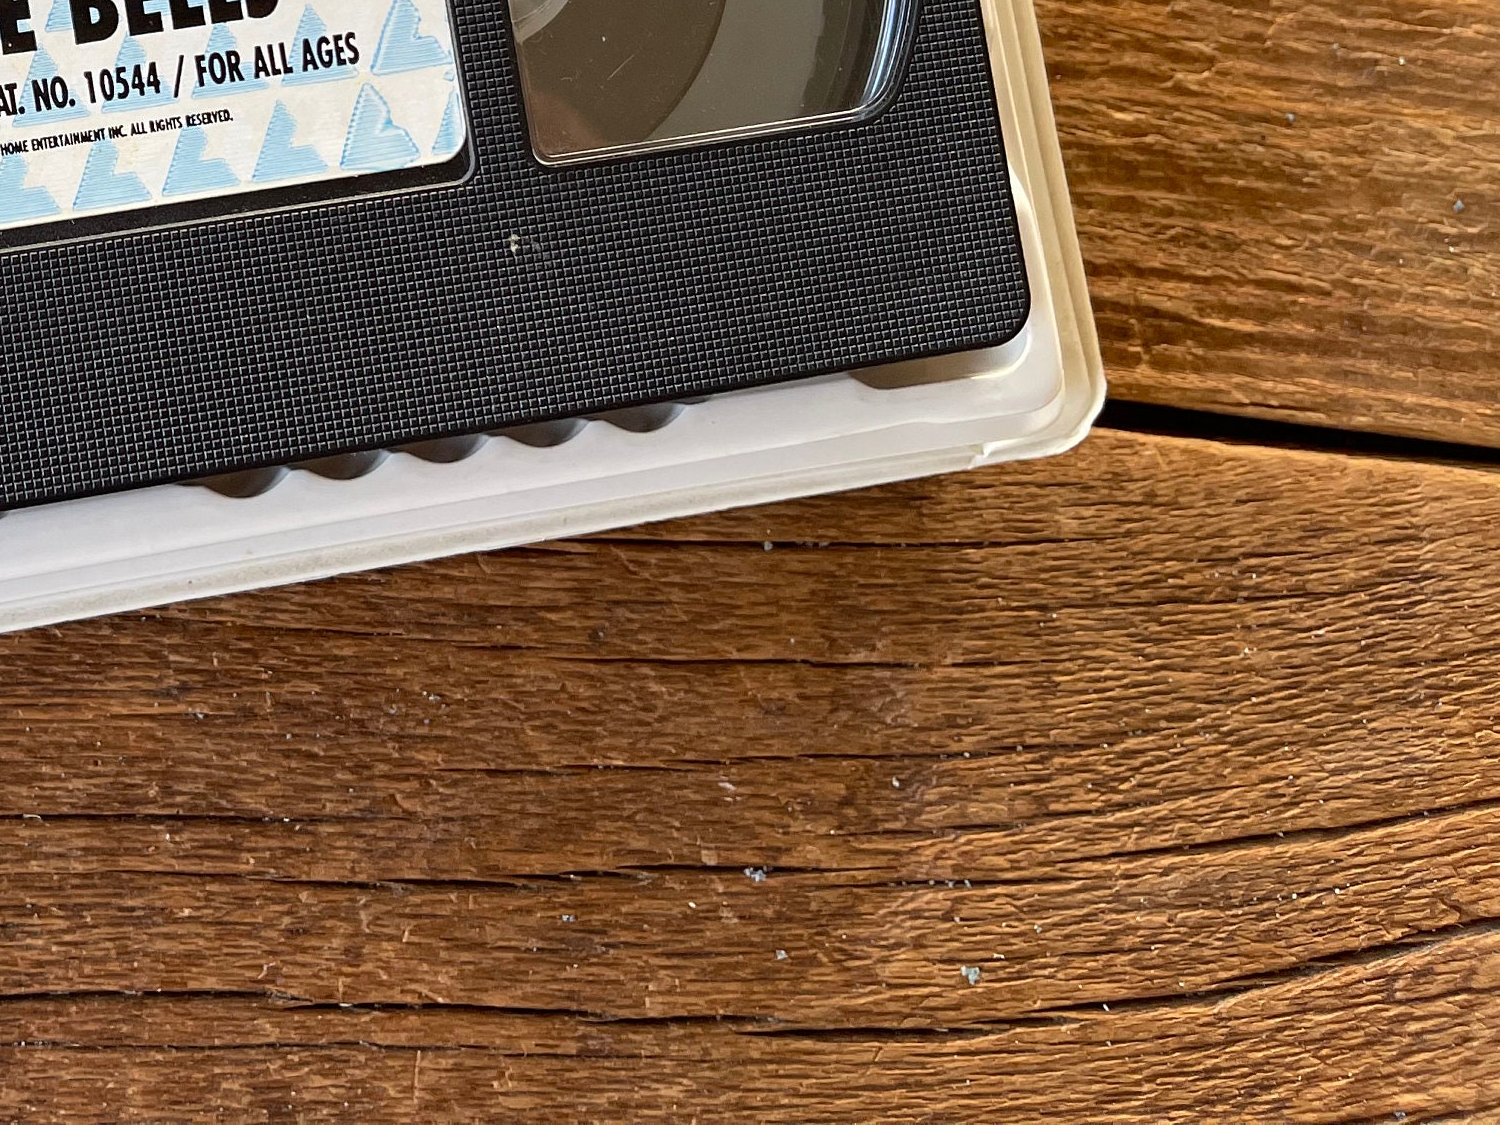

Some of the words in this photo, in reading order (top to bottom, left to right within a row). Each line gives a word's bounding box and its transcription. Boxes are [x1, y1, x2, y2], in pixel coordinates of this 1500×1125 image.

[32, 75, 76, 113] NO.
[83, 61, 161, 104] 10544
[173, 54, 185, 98] /
[194, 49, 245, 88] FOR
[253, 41, 294, 80] ALL
[301, 31, 360, 74] AGES
[0, 139, 29, 157] HOME
[30, 127, 106, 152] ENTERTAINMENT
[108, 124, 128, 140] INC.
[130, 121, 145, 137] ALL
[149, 115, 183, 134] RIGHTS
[185, 108, 234, 128] RESERVED.
